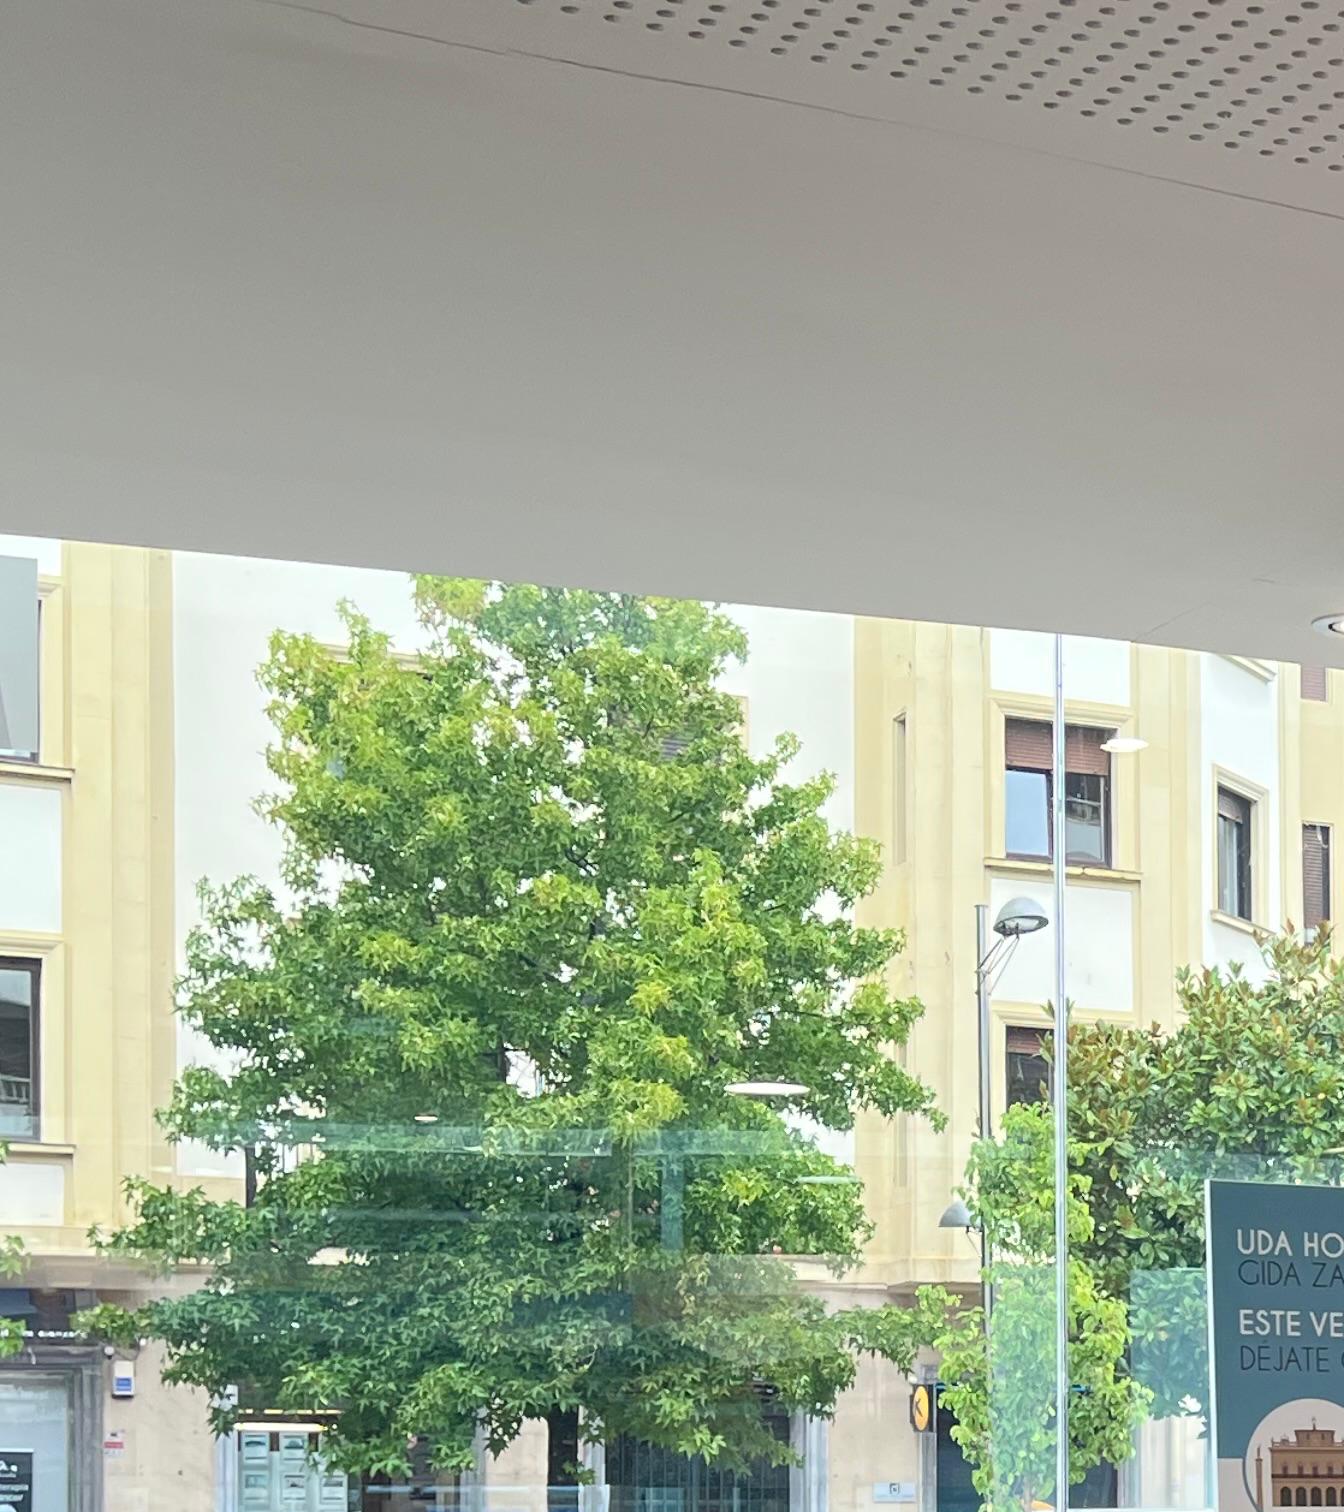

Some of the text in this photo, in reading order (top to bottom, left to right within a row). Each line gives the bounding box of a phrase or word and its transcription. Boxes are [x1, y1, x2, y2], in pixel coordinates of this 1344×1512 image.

[1237, 1228, 1293, 1257] UDA
[1238, 1259, 1301, 1288] GIDA
[1239, 1309, 1301, 1337] ESTE
[1240, 1339, 1330, 1374] DÉJATE
